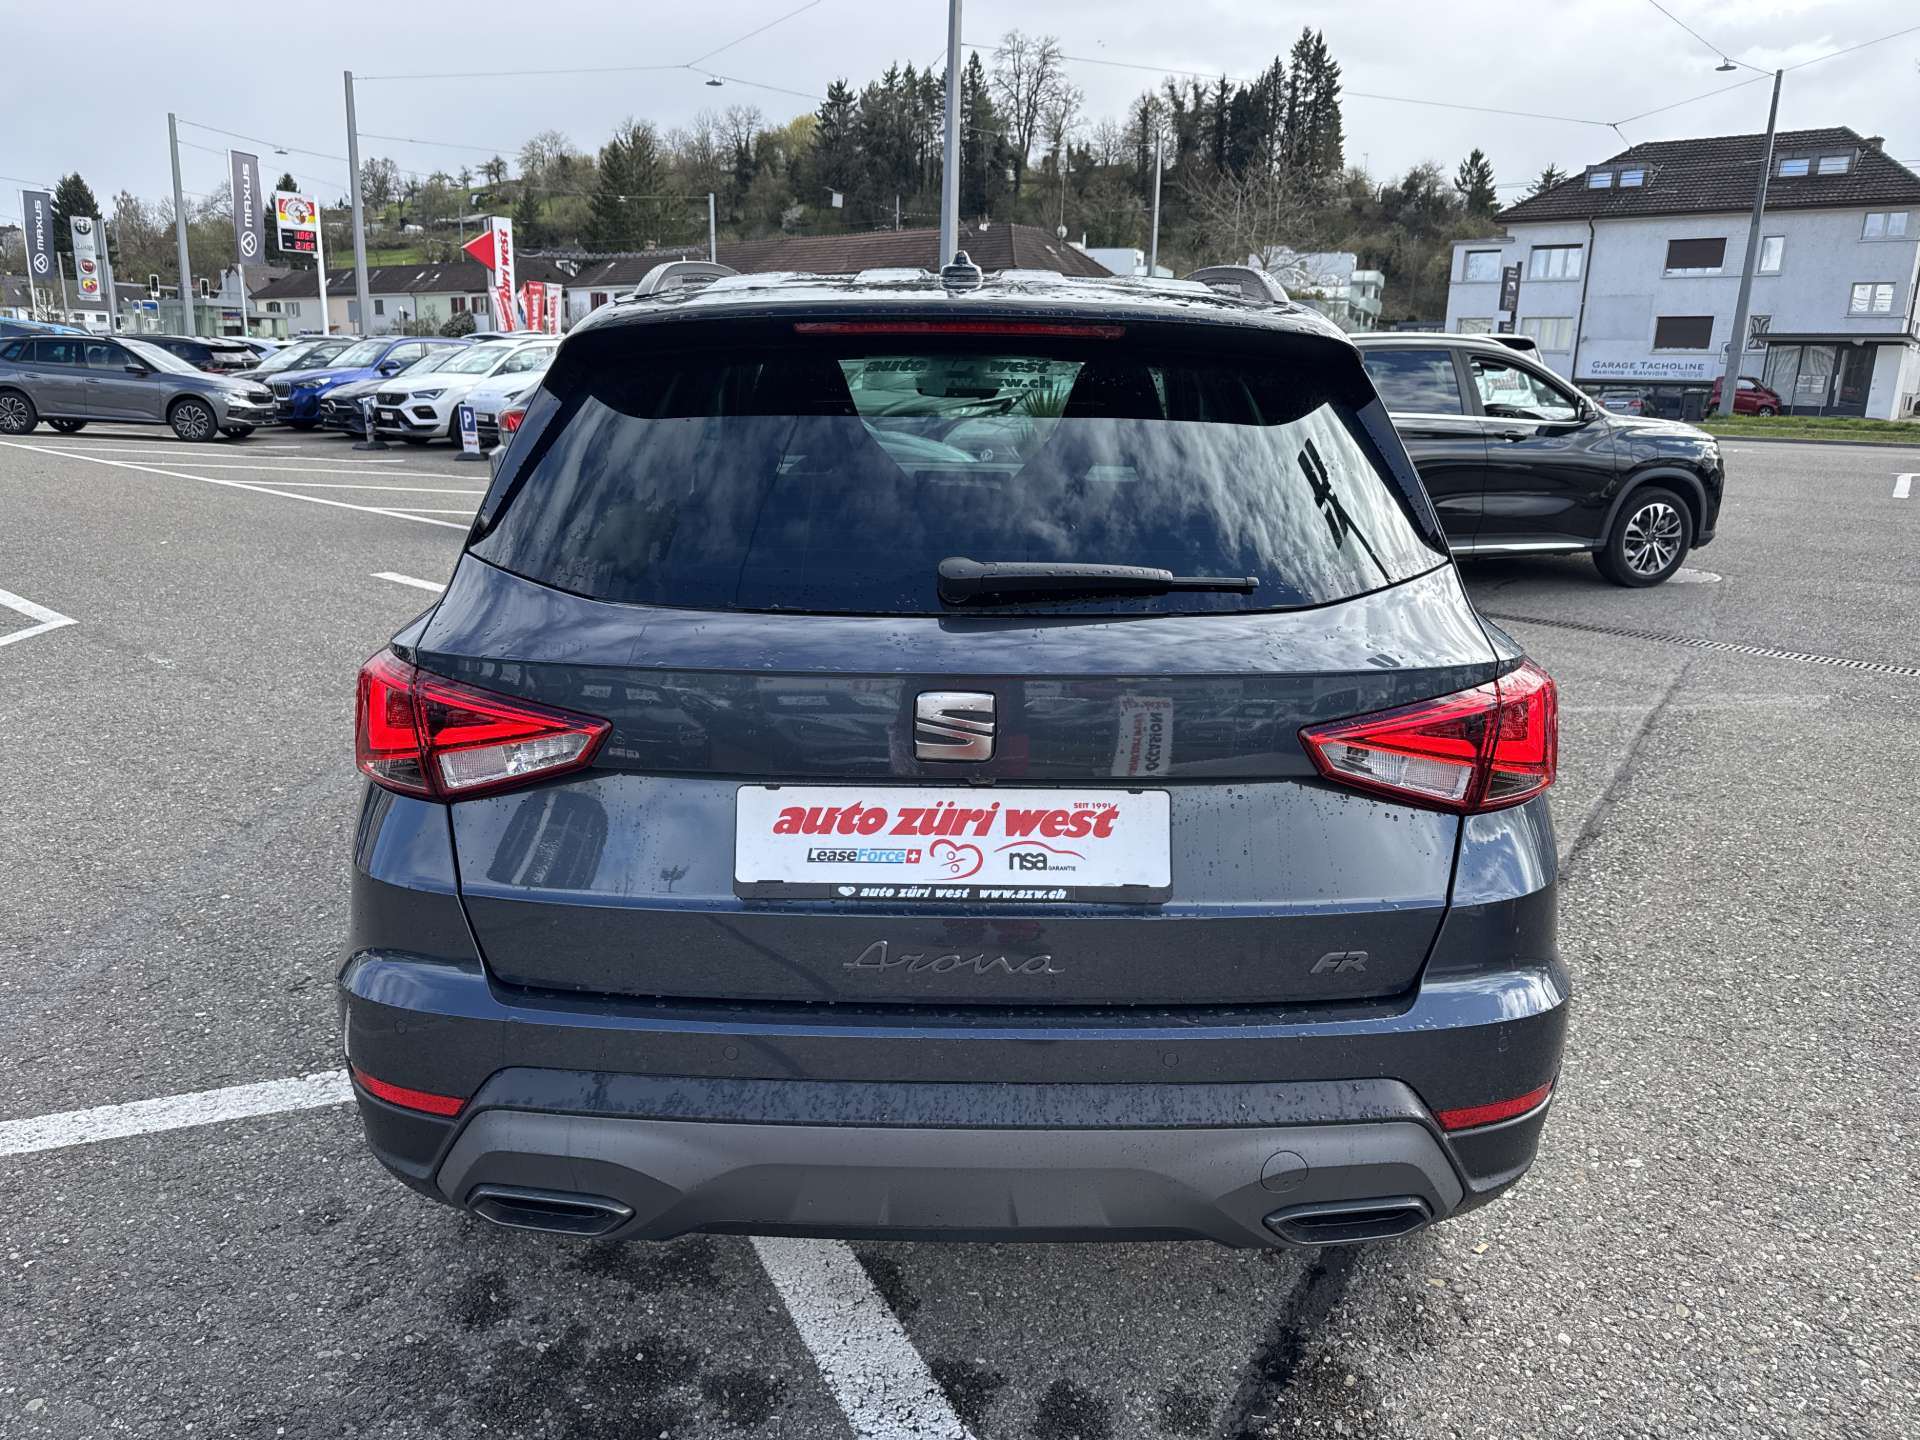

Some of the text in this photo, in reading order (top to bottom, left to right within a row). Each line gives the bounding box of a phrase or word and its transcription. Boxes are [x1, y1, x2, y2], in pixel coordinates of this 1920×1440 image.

[242, 163, 253, 228] MAXUS
[34, 199, 45, 251] MAXUS
[864, 358, 927, 372] auto
[1592, 360, 1705, 371] GARAGE TACHOLINE
[463, 410, 472, 429] P
[772, 800, 1120, 838] auto züri west
[807, 848, 905, 864] LeaseForce
[1009, 852, 1047, 870] nsa
[860, 886, 1067, 899] auto züri west www.azw.ch
[842, 940, 1066, 975] Arona
[1309, 950, 1369, 974] FR
